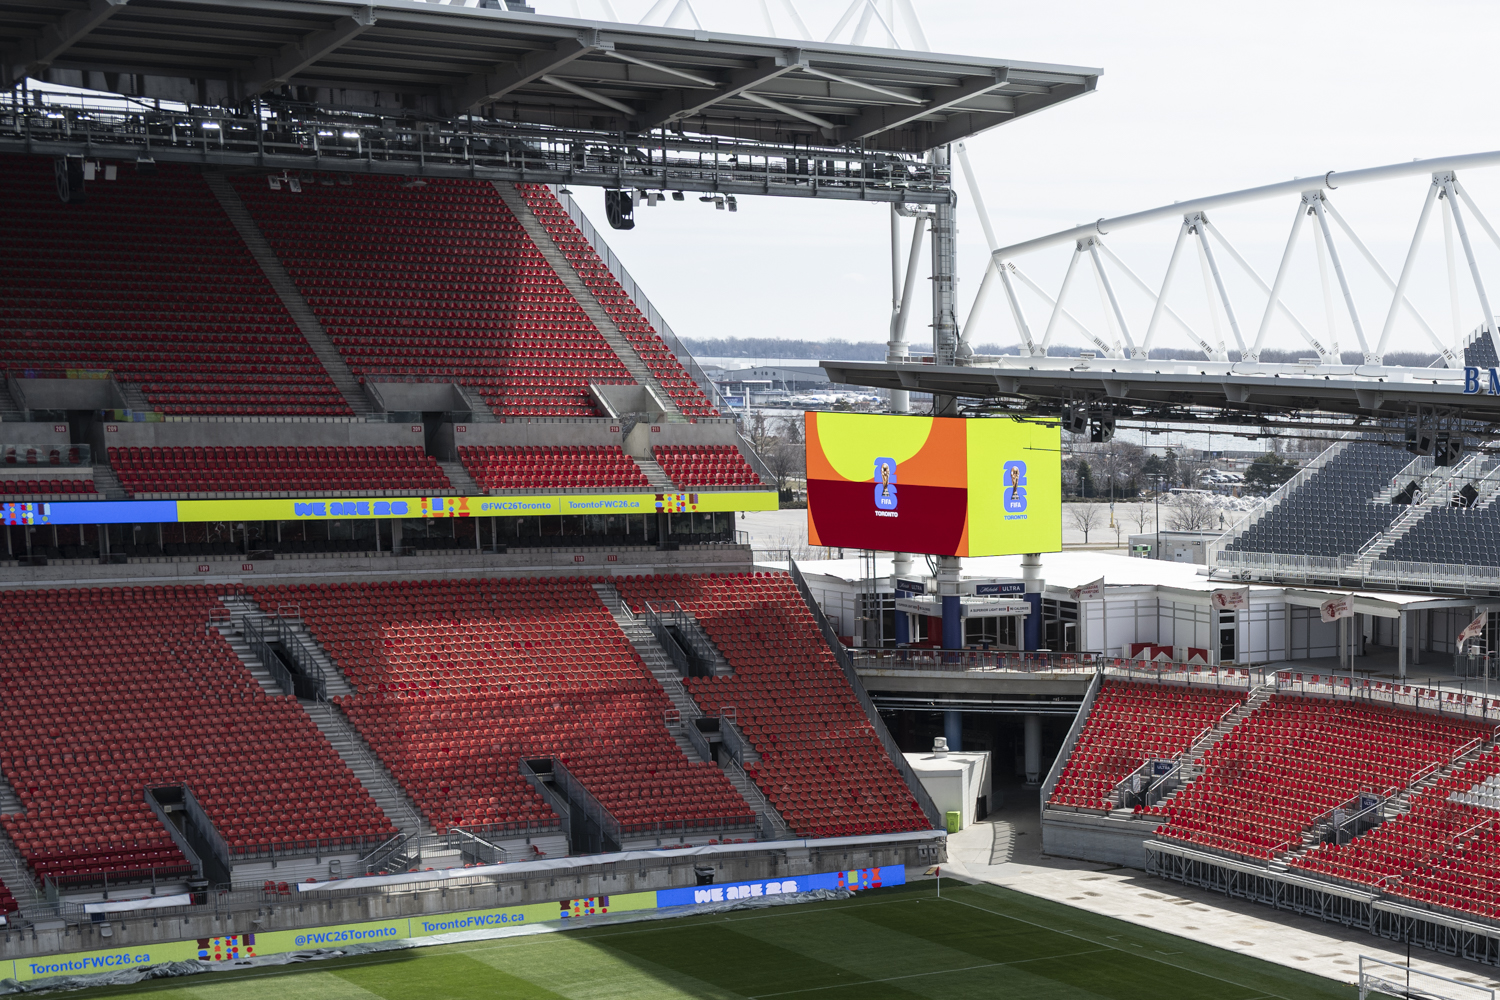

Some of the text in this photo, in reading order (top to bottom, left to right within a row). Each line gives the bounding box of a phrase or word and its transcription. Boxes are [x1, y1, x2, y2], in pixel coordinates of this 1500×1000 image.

[294, 500, 640, 517] WE ARE 26 @FWC26Toronto TorontoFWC26.ca
[875, 510, 899, 518] TORONTO
[1010, 501, 1022, 509] FIFA
[694, 880, 798, 904] WE ARE 26
[294, 912, 525, 947] @FWC26Toronto TorontoFWC26.ca
[29, 951, 151, 975] TorontoFWC26.ca
